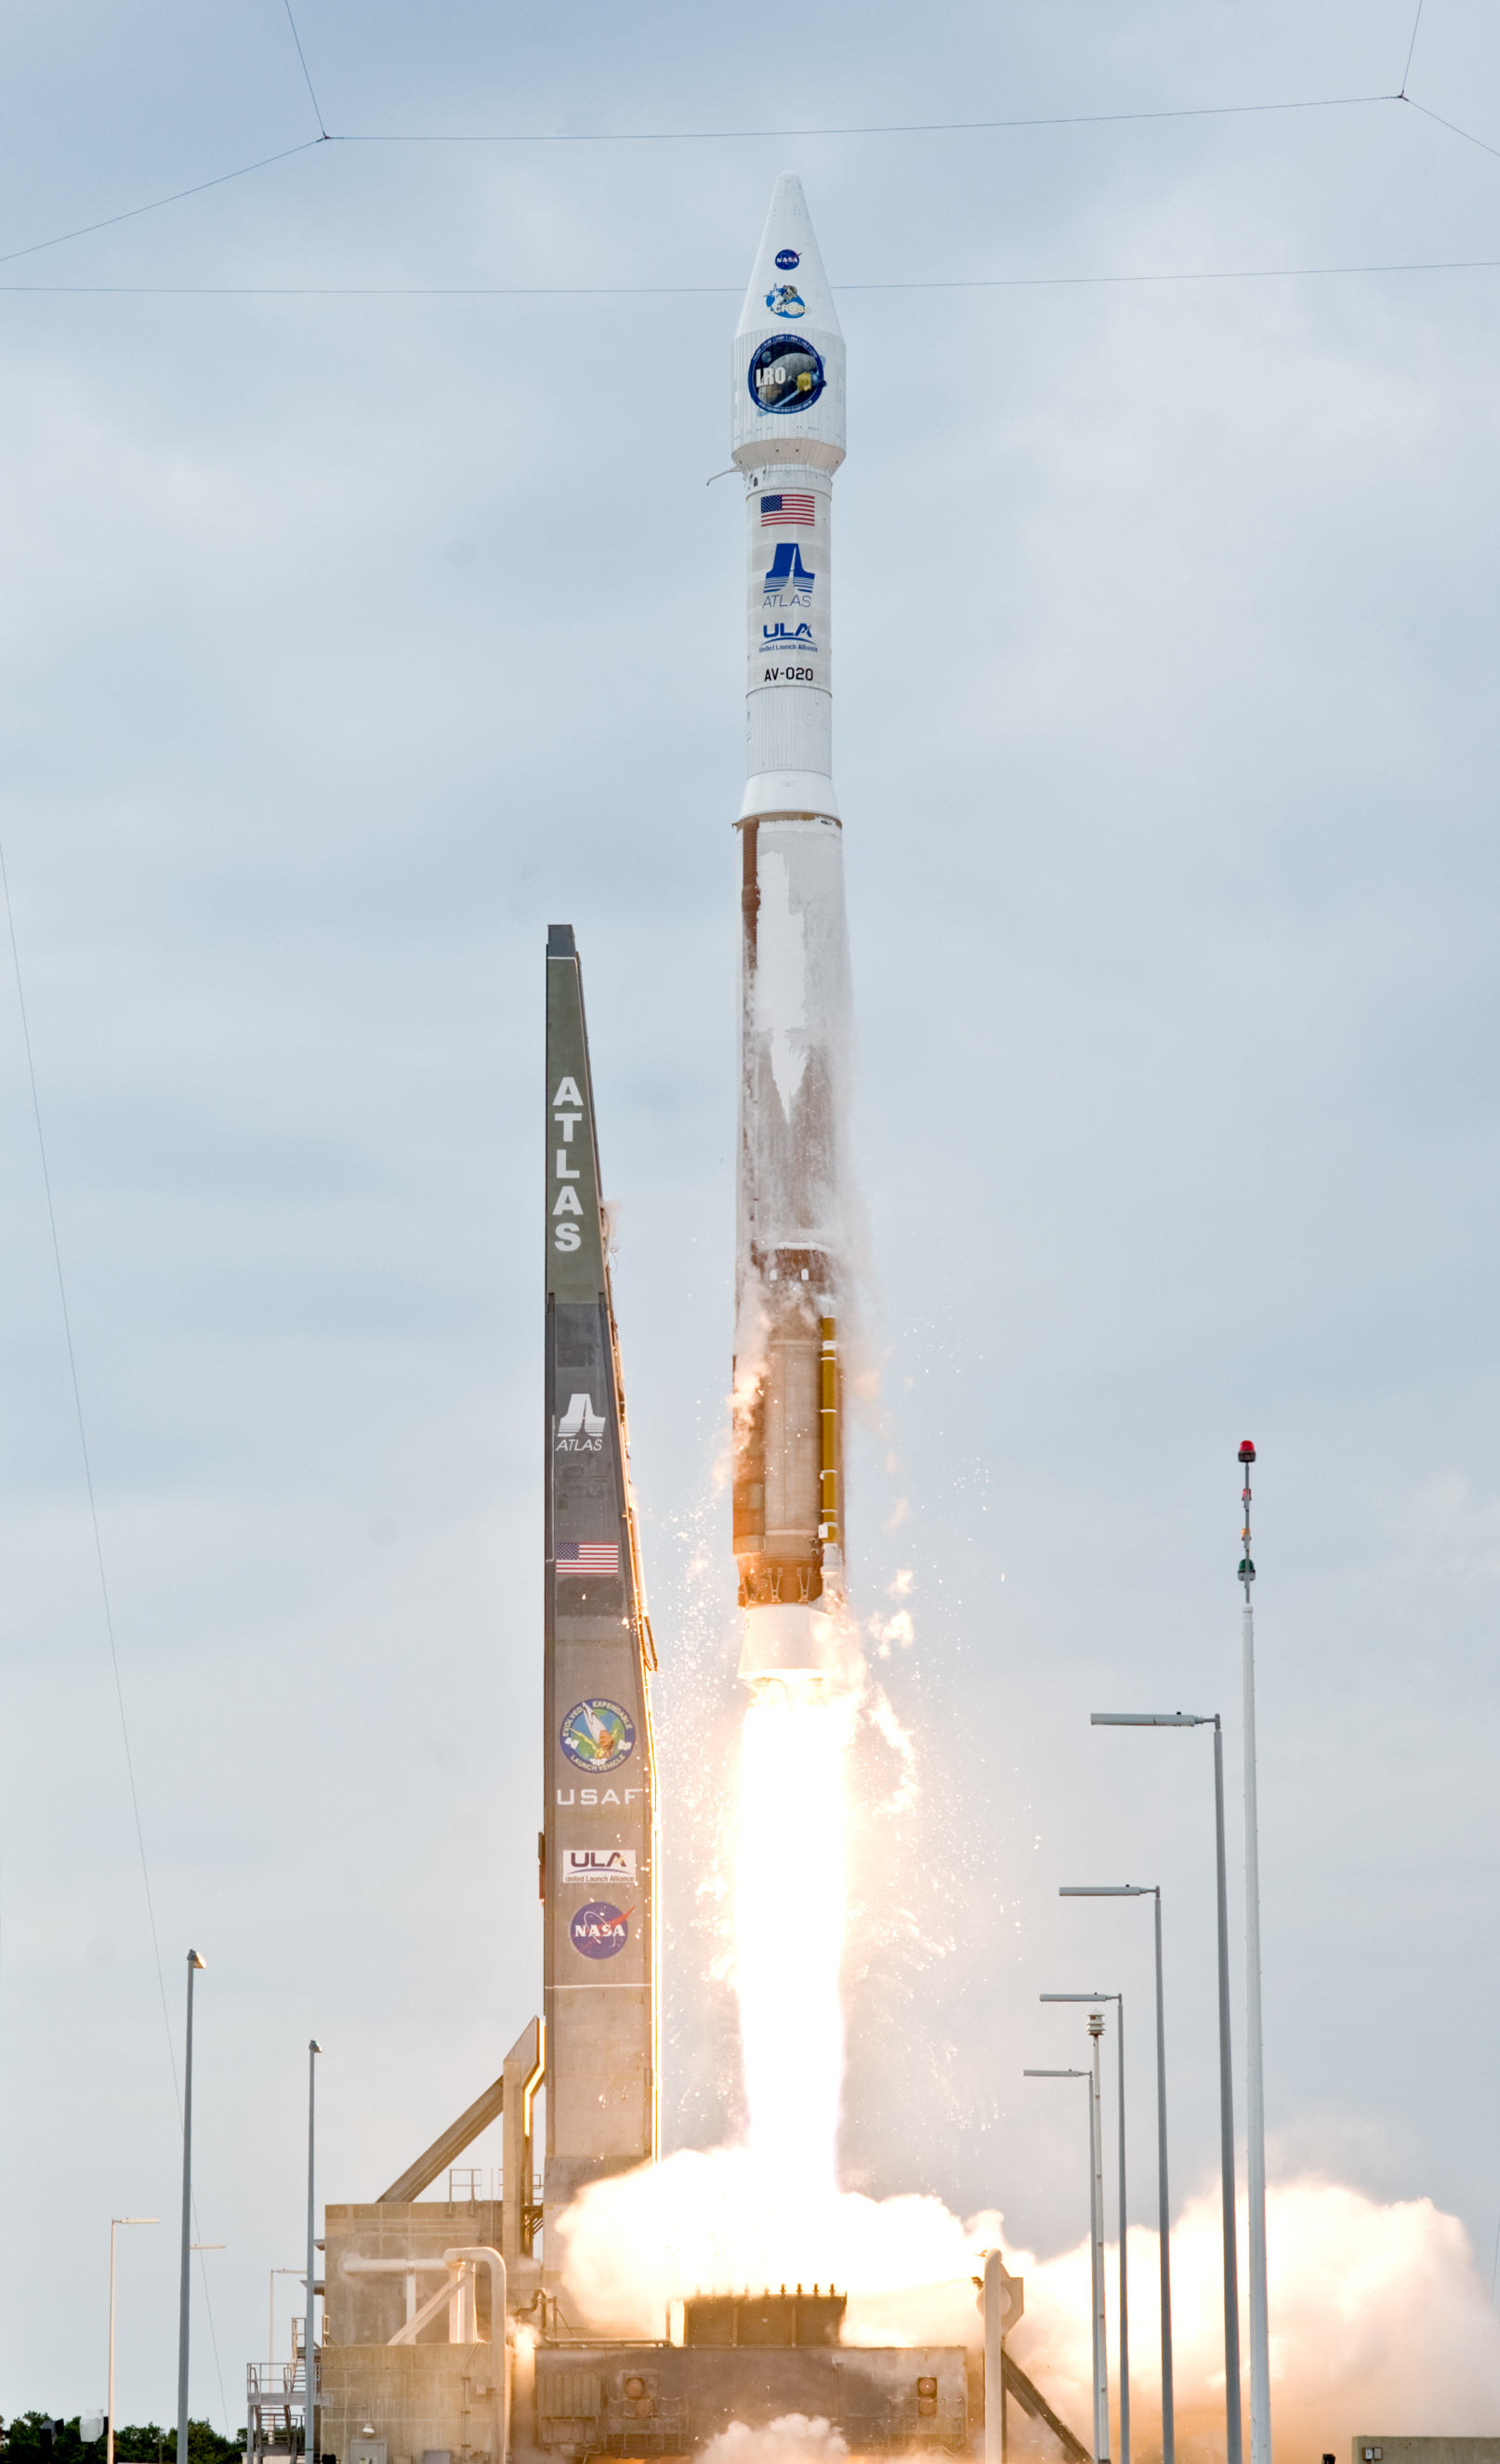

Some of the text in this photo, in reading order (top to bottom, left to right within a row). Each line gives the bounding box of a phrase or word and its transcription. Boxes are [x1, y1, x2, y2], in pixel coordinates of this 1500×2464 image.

[767, 304, 811, 315] LCROSS
[756, 366, 786, 388] LRO
[762, 594, 811, 609] ATLAS
[763, 623, 812, 639] ULA
[797, 643, 818, 652] Alliance
[764, 666, 813, 682] AV-020
[552, 1076, 584, 1252] ATLAS
[555, 1439, 603, 1452] ATLAS
[562, 1701, 633, 1737] EVOLVED EXPENDABLE
[570, 1754, 625, 1771] LAUNCH VEHICLE
[557, 1788, 640, 1805] USAF
[571, 1851, 627, 1867] ULA
[574, 1924, 625, 1937] NASA
